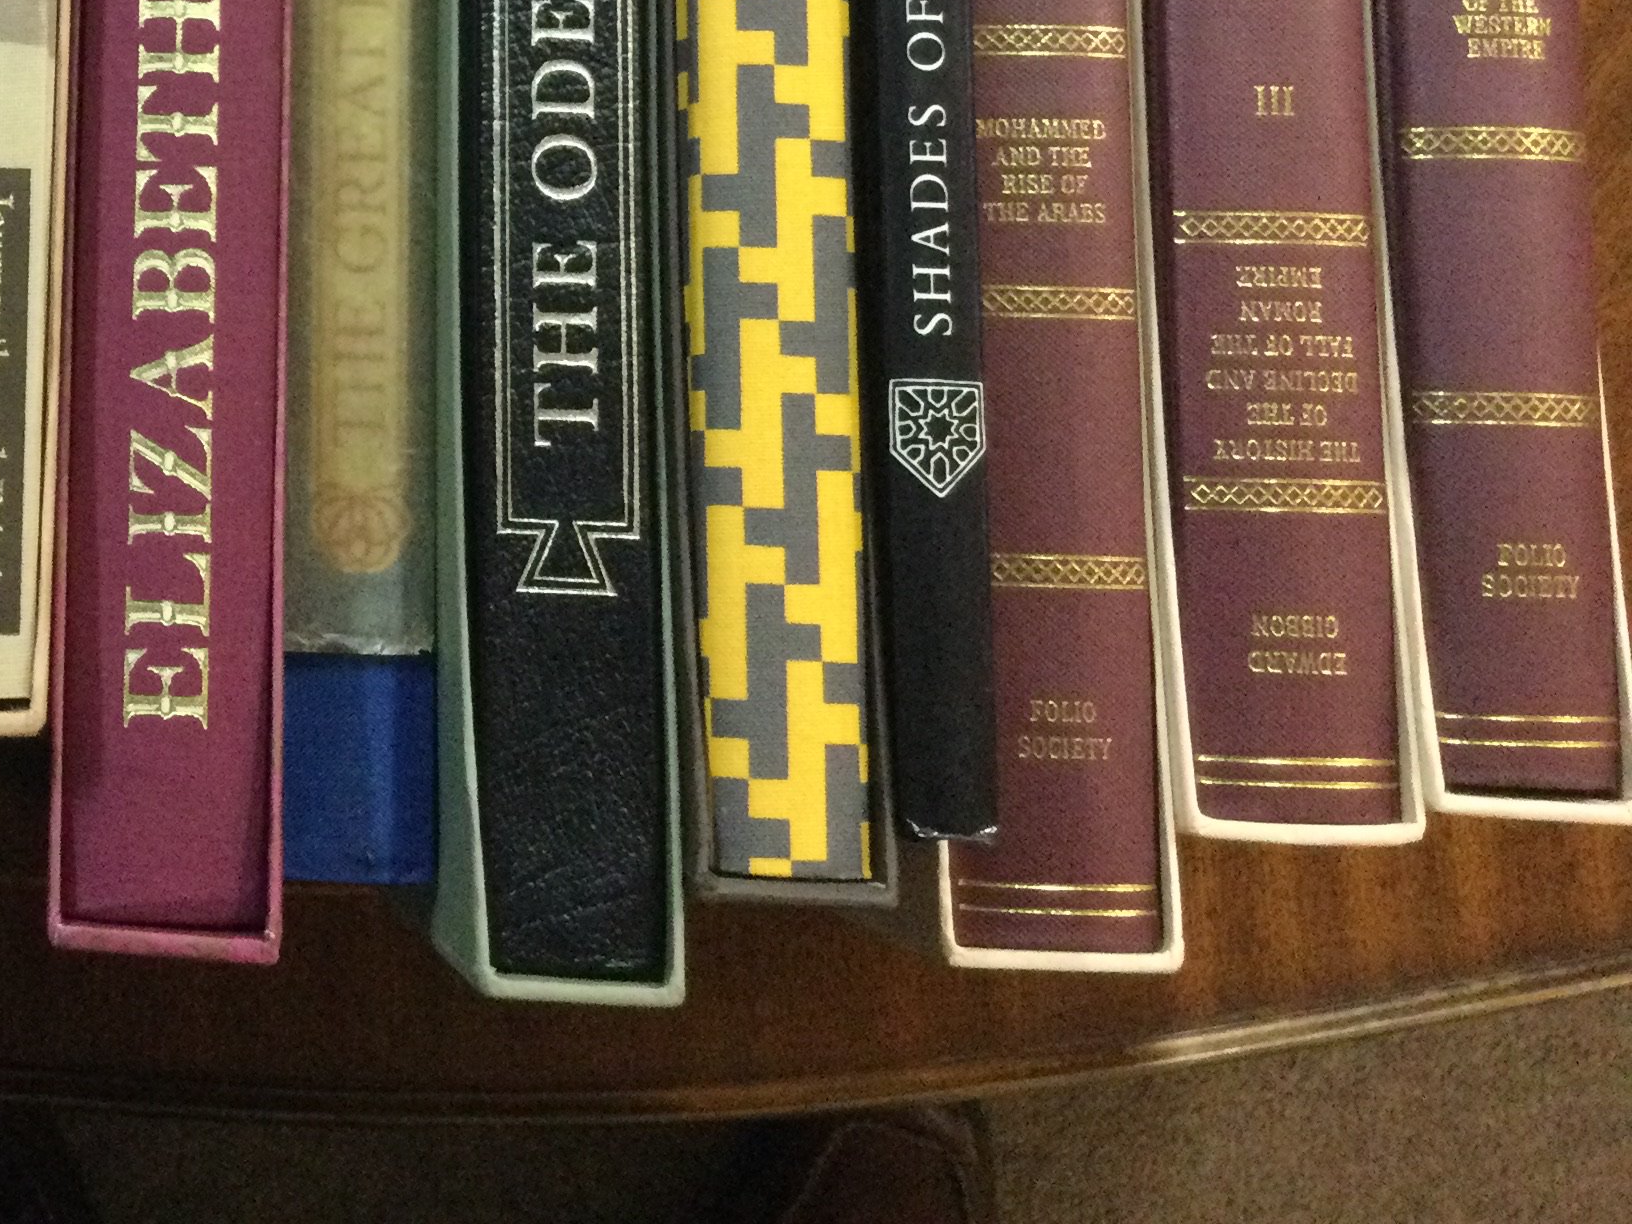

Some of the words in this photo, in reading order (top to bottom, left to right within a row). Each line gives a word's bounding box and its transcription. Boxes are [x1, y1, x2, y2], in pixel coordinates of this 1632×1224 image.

[1452, 15, 1553, 37] WESTERN
[1467, 38, 1548, 61] EMPIRE
[975, 117, 1107, 141] MOHAMMED
[991, 146, 1043, 169] AND
[1048, 146, 1093, 169] THE
[1001, 174, 1055, 195] RISE
[1060, 174, 1088, 195] OF
[907, 103, 954, 338] SHADES
[982, 201, 1030, 224] THE
[1037, 202, 1107, 224] ARABS
[532, 240, 601, 449] THE
[1496, 543, 1567, 568] FOLIO
[1481, 574, 1580, 600] SOCIETY
[1029, 700, 1098, 724] FOLIO
[1019, 736, 1113, 761] SOCIETY
